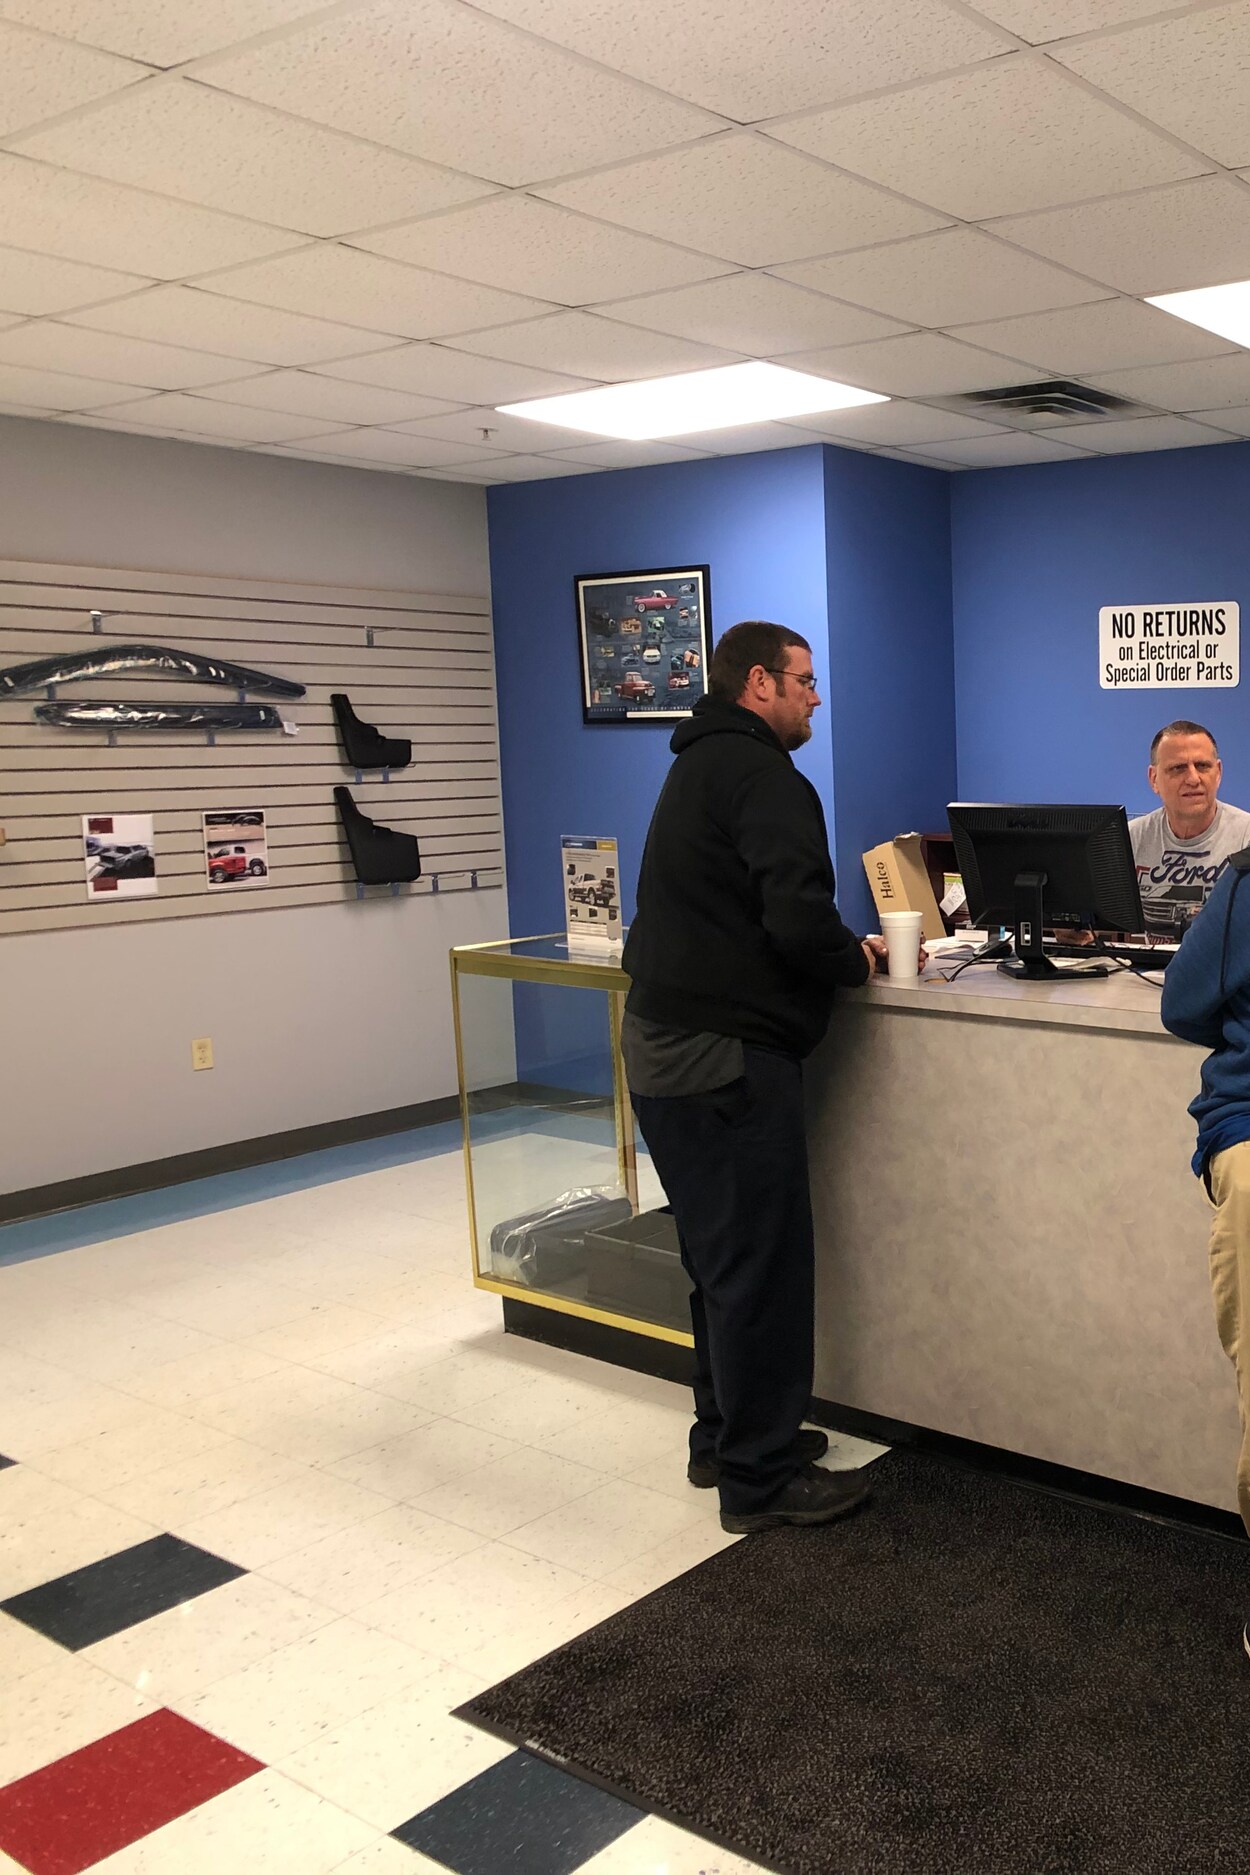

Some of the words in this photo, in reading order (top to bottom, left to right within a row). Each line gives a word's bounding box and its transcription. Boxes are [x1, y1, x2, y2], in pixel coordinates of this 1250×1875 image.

[1112, 612, 1135, 638] NO
[1143, 608, 1226, 638] RETURNS
[1119, 646, 1133, 661] on
[1139, 640, 1200, 660] Electrical
[1205, 643, 1219, 659] or
[1105, 662, 1150, 686] Special
[1155, 661, 1191, 682] Order
[1197, 661, 1233, 681] Parts
[876, 862, 894, 899] Halco
[1150, 851, 1230, 885] Ford
